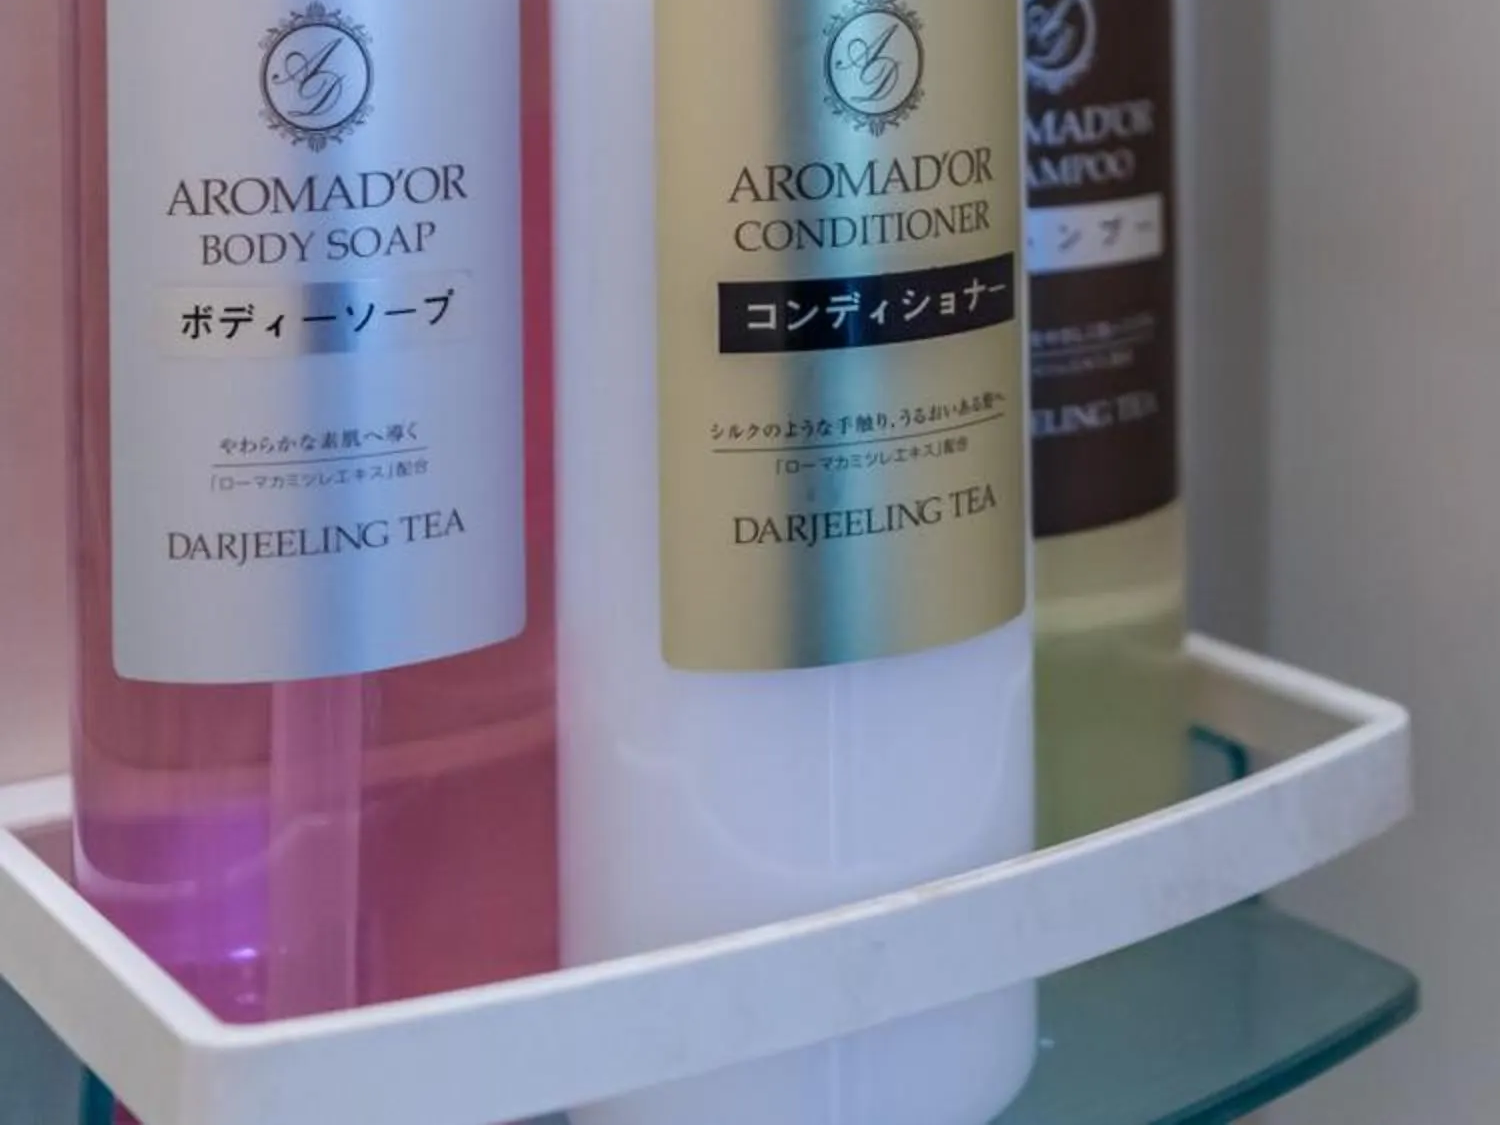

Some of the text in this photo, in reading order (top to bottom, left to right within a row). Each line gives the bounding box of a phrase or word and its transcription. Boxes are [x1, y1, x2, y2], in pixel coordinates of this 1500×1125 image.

[1024, 98, 1155, 147] MAD'OR
[166, 163, 469, 217] AROMAD'OR
[728, 146, 994, 204] AROMAD'OR
[201, 221, 437, 266] BODY SOAP
[734, 200, 991, 252] CONDITIONER
[181, 288, 456, 340] ボディーソープ
[747, 277, 1007, 331] コンディショナー
[219, 420, 419, 456] やわらかな素肌へ導く
[167, 507, 467, 566] DARJEELING TEA
[733, 483, 998, 548] DARJEELING TEA
